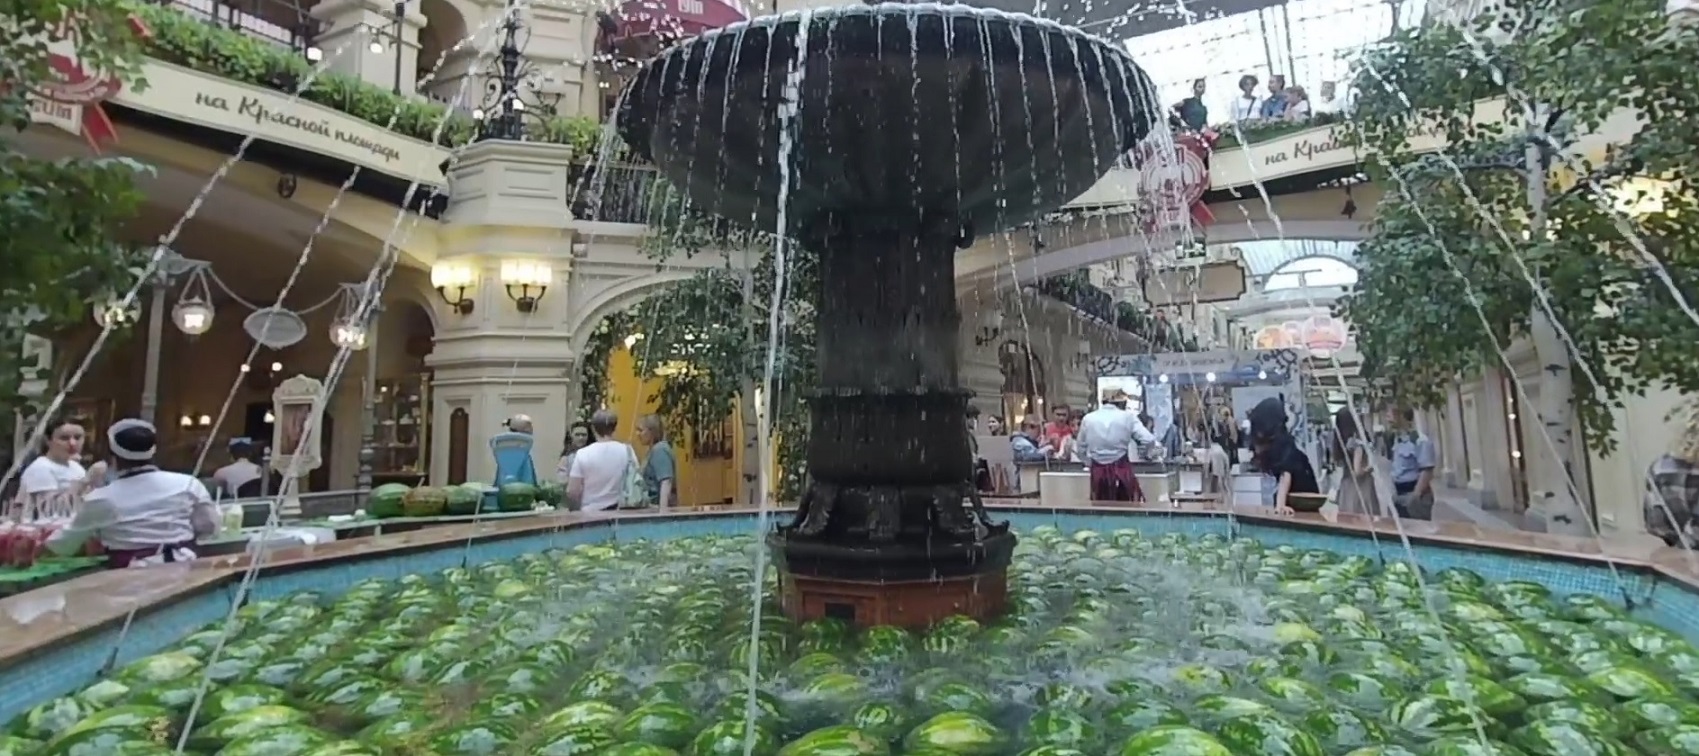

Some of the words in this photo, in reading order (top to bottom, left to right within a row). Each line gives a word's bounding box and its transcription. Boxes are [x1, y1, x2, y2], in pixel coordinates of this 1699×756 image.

[195, 91, 230, 111] на
[237, 95, 331, 137] Красной
[335, 130, 401, 162] площади
[1265, 152, 1292, 165] на
